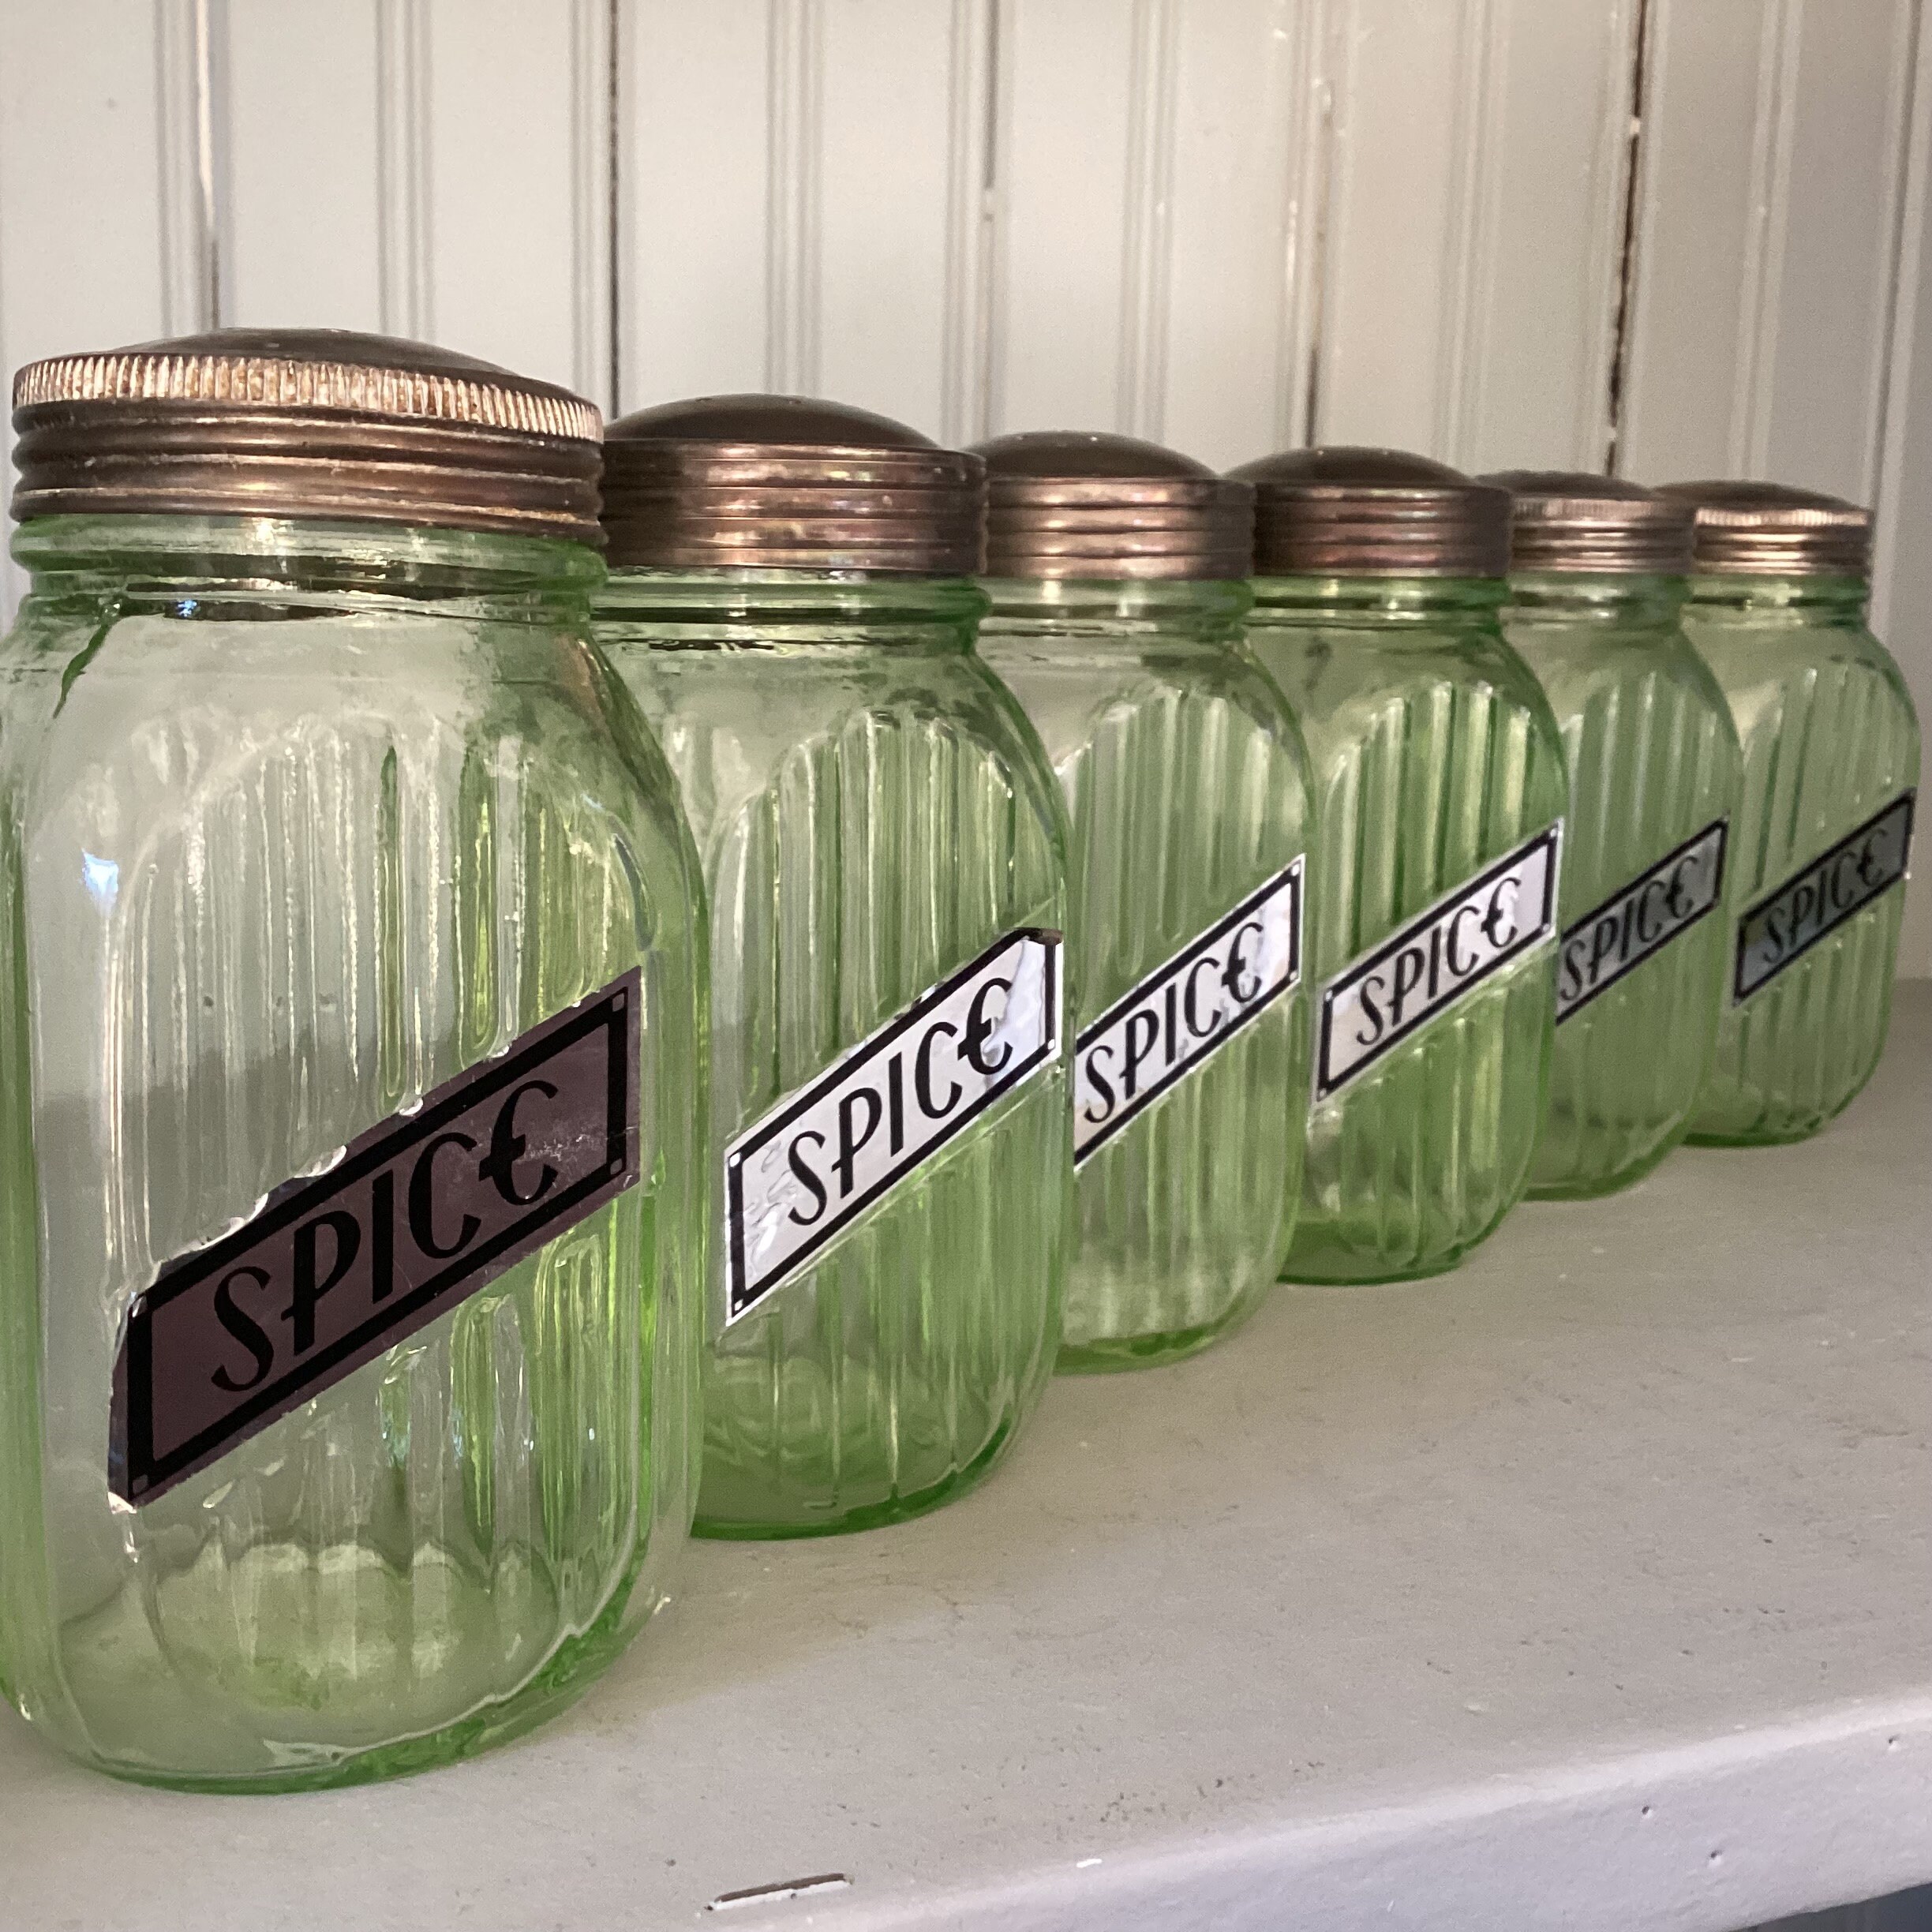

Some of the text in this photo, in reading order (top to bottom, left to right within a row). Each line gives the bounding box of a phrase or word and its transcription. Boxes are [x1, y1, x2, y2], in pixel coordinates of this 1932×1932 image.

[1356, 877, 1522, 1046] SPICE
[1559, 856, 1698, 1001] SPICE
[1762, 828, 1888, 964] SPICE
[788, 978, 1013, 1226] SPICE
[1084, 922, 1263, 1124] SPICE
[211, 1080, 559, 1392] SPICE
